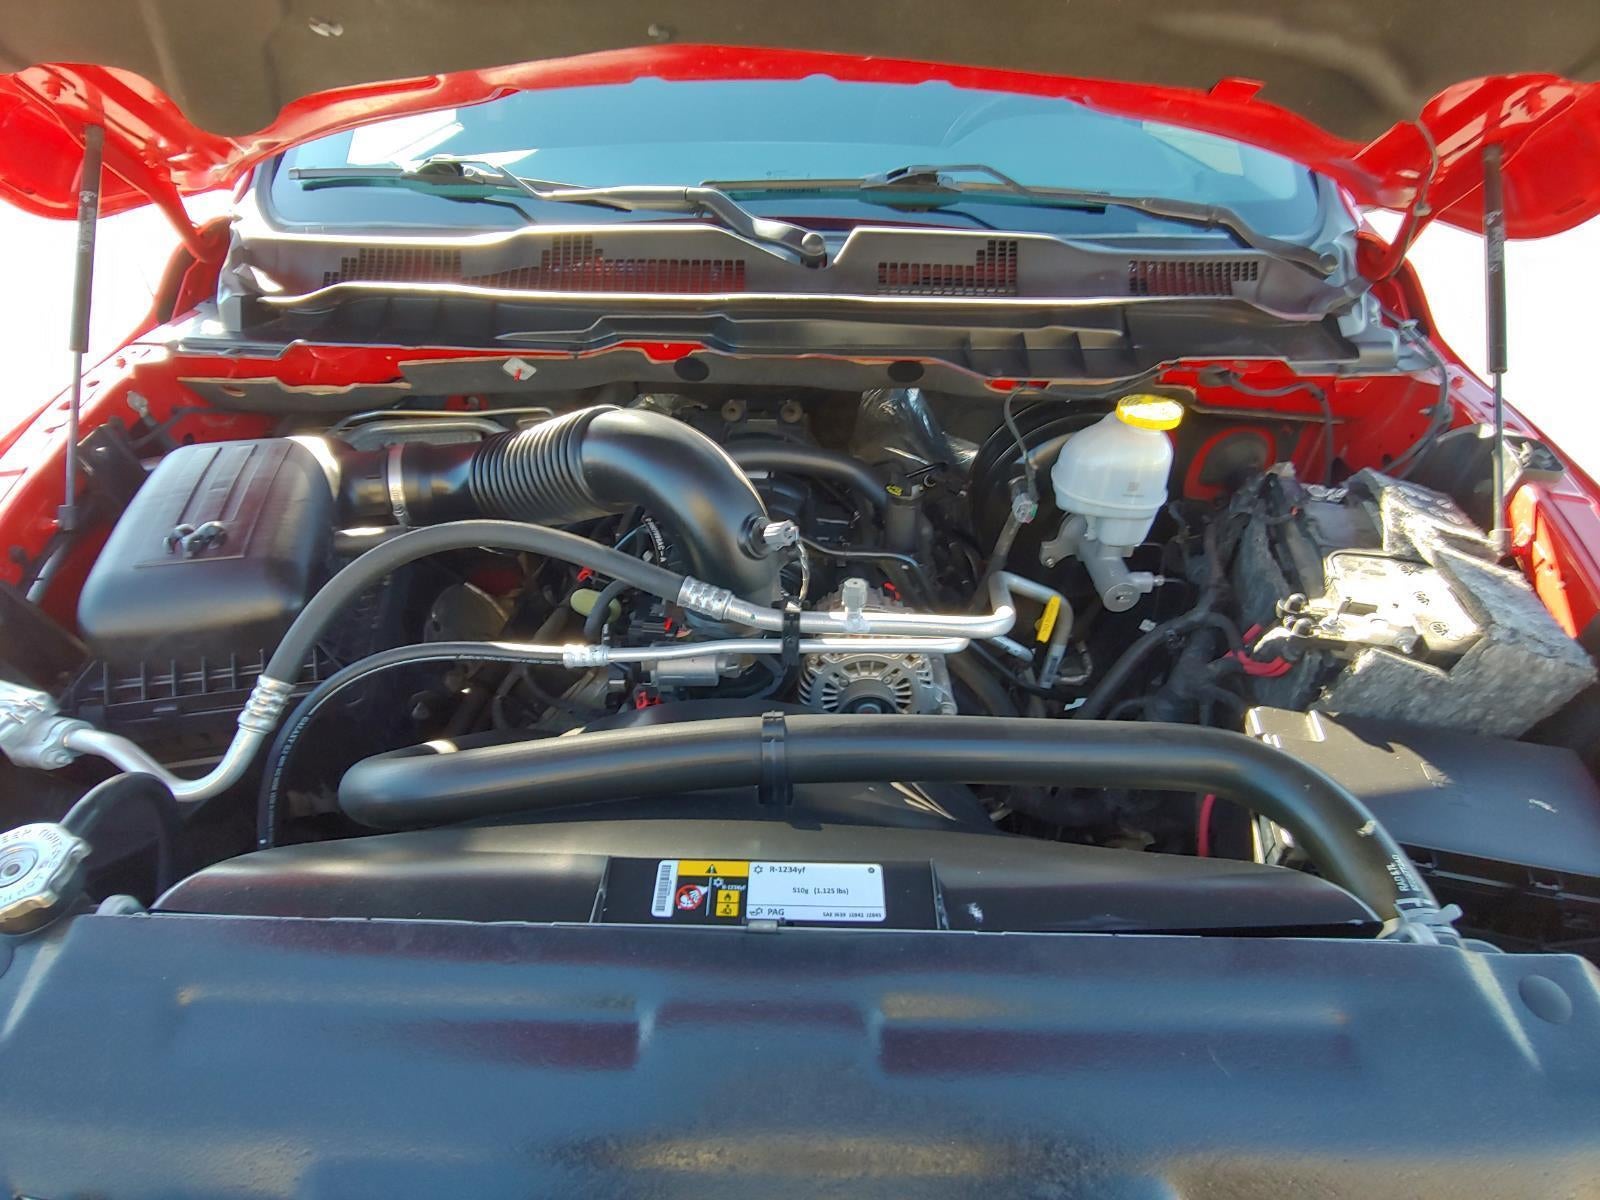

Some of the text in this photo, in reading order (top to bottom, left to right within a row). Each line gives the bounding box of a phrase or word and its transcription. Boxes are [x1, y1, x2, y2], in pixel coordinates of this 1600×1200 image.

[769, 866, 806, 874] R-1234yf
[792, 887, 809, 895] 510g
[814, 887, 835, 895] (1.125
[767, 908, 785, 917] PAG
